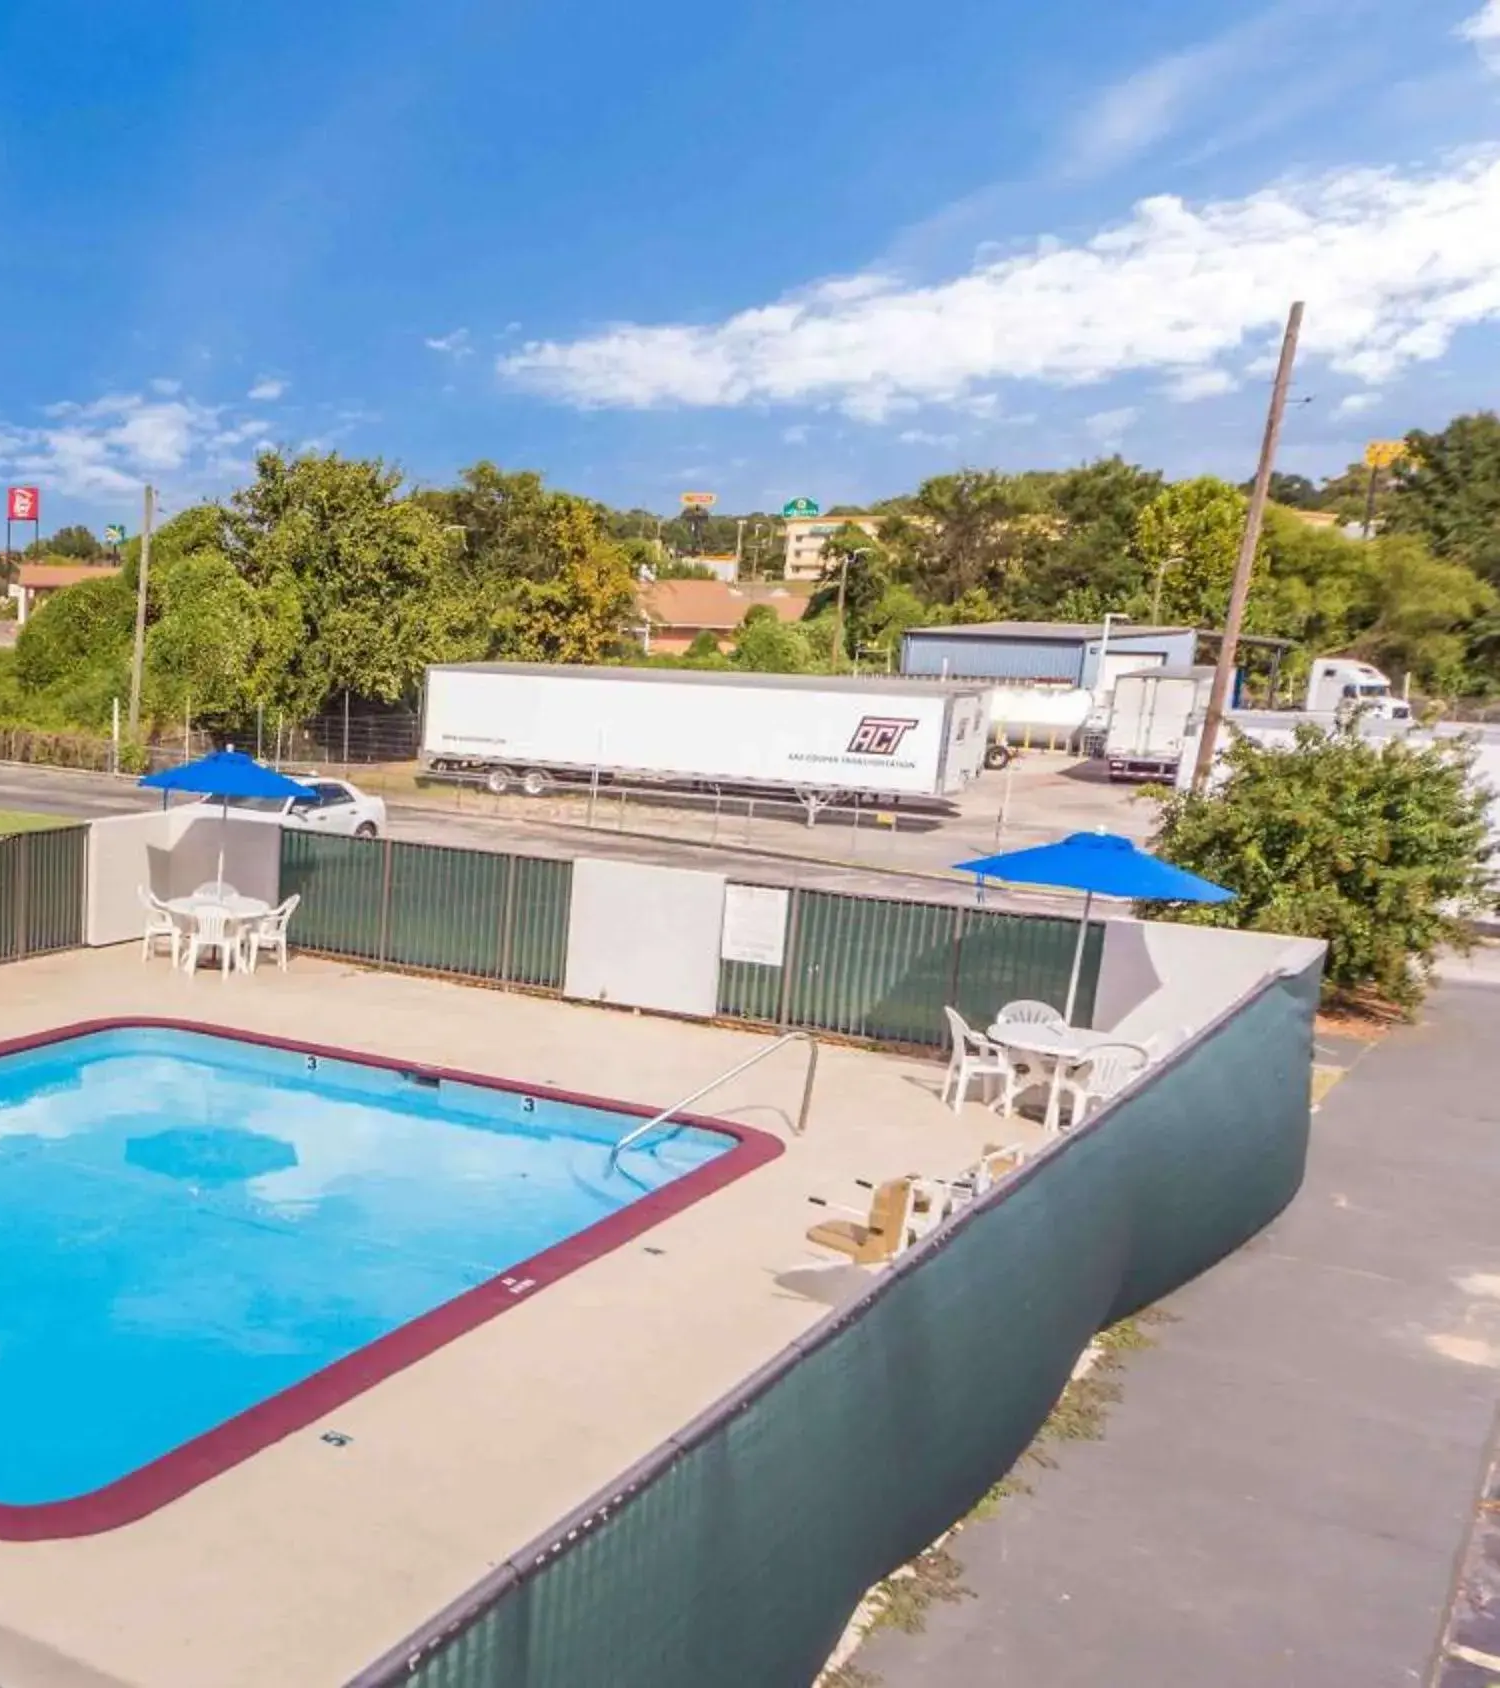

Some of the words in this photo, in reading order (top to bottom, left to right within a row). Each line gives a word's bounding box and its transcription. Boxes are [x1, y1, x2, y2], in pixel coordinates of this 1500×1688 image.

[846, 716, 919, 755] ACT
[307, 1057, 317, 1070] 3
[523, 1098, 534, 1112] 3
